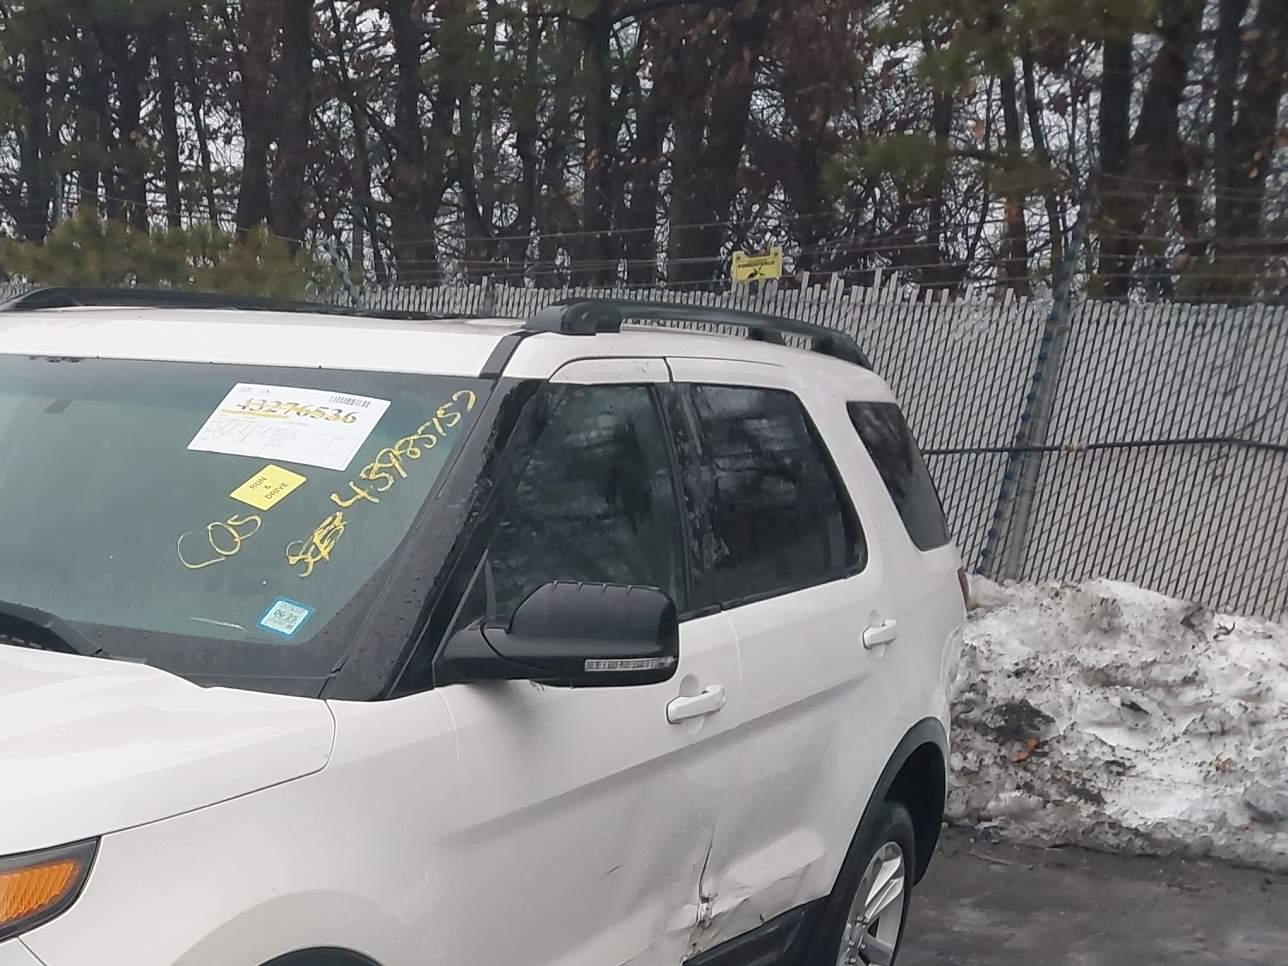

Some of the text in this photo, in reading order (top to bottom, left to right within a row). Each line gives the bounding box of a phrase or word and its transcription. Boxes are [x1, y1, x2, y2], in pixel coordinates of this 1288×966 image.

[235, 397, 360, 425] 43276536
[250, 476, 268, 489] RUN
[265, 481, 289, 499] DRIVE
